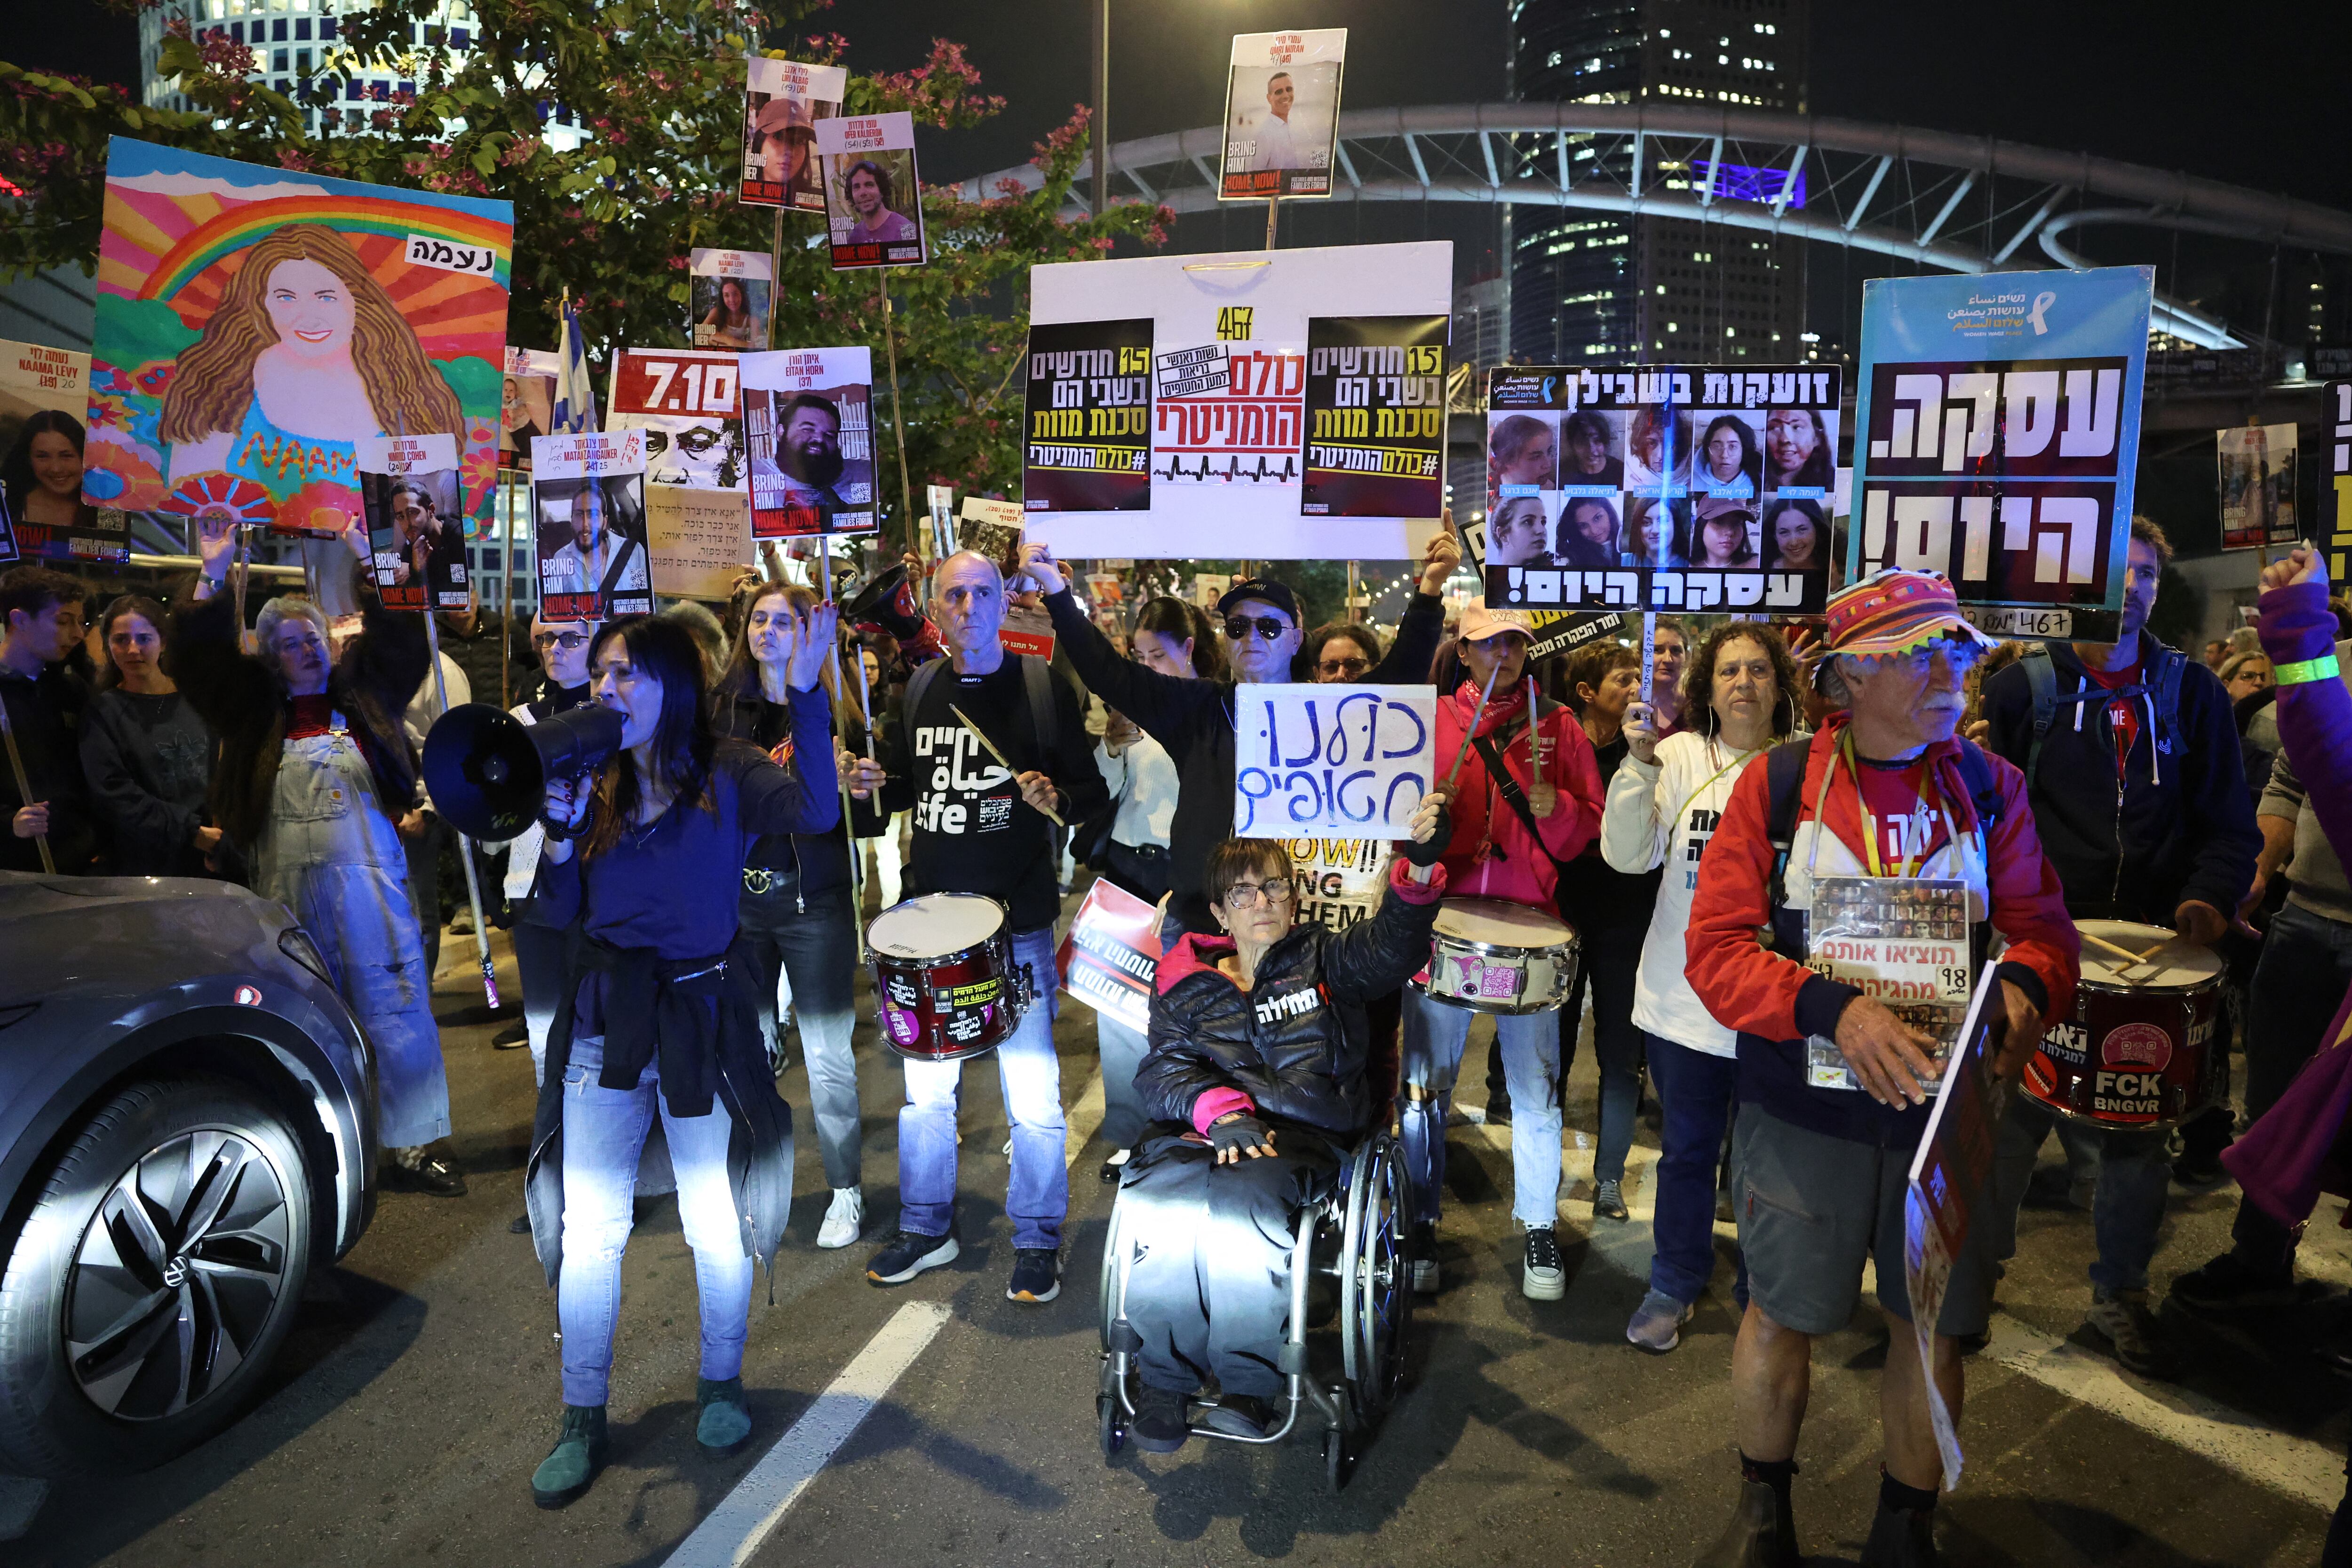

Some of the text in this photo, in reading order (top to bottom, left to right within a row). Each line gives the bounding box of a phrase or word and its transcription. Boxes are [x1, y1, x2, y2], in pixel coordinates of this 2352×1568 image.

[1288, 35, 1302, 44] עמרי
[1270, 45, 1304, 55] OMRI MIRAN
[792, 76, 808, 85] ALBAG
[866, 119, 877, 128] עופר
[858, 128, 882, 138] KALDERON
[1228, 141, 1256, 156] BRING
[745, 152, 767, 167] BRING
[1226, 158, 1245, 173] HIM
[744, 166, 757, 180] HER
[1225, 170, 1281, 190] HOME NOW!
[743, 181, 762, 195] HOME
[830, 216, 854, 231] BRING
[832, 231, 847, 245] HIM
[413, 241, 493, 271] נעמה
[833, 247, 856, 260] HOME
[1968, 294, 2026, 304] נשים نساء
[1987, 306, 2025, 315] עושות
[694, 324, 716, 334] BRING
[1218, 307, 1253, 340] 467
[1953, 317, 2024, 331] שלום السلام
[695, 334, 708, 345] HER
[30, 348, 68, 364] נעמה לוי
[789, 354, 819, 366] איתן הורן
[1167, 347, 1218, 366] נשות ואנשי
[1311, 346, 1438, 375] 15 חודשים
[19, 359, 78, 378] NAAMA LEVY
[786, 365, 824, 376] EITAN HORN
[1031, 349, 1113, 380] חודשים
[1179, 363, 1210, 379] בריאות
[1228, 350, 1305, 396] כולם
[61, 380, 75, 389] 20
[645, 362, 738, 412] 7.10
[799, 376, 811, 387] (37)
[1165, 373, 1227, 396] למען החטופים
[1052, 377, 1147, 408] בשבי הם
[1335, 377, 1440, 406] בשבי הם
[1566, 369, 1829, 413] זועקות בשבילן
[1033, 407, 1146, 438] סכנת מוות
[1156, 405, 1302, 446] הומניטרי
[1313, 408, 1439, 438] סכנת מוות
[1870, 369, 2121, 471] עסקה.
[401, 440, 417, 450] נמרוד
[599, 438, 608, 449] מתן
[237, 431, 360, 481] NAAM
[407, 451, 426, 461] COHEN
[584, 449, 617, 461] ZANGAUKER
[753, 474, 785, 492] BRING
[1565, 487, 1586, 495] גלבוע
[754, 492, 775, 509] HIM
[755, 510, 786, 529] HOME
[2224, 507, 2245, 519] BRING
[833, 517, 873, 527] FAMILIES FORUM
[2225, 518, 2239, 530] HIM
[1865, 490, 2099, 584] היום!
[374, 552, 401, 569] BRING
[541, 558, 574, 576] BRING
[377, 570, 395, 585] HIM
[543, 577, 564, 594] HIM
[1508, 567, 1803, 610] עסקה היום!
[381, 588, 405, 603] HOME
[544, 596, 573, 613] HOME
[613, 604, 650, 613] FAMILIES FORUM
[1490, 613, 1522, 625] WAR
[2021, 612, 2067, 634] 467
[1554, 622, 1597, 649] הפקרה
[980, 804, 1011, 814] לכיבוש
[981, 797, 1012, 806] מסתכלים
[979, 812, 1009, 822] בעיניים
[1823, 941, 1956, 964] תוציאו אותם
[1942, 968, 1967, 988] 98
[974, 984, 988, 993] מעגל
[2047, 1045, 2086, 1064] למגילת
[2096, 1071, 2161, 1096] FCK
[2095, 1097, 2159, 1112] BNGVR
